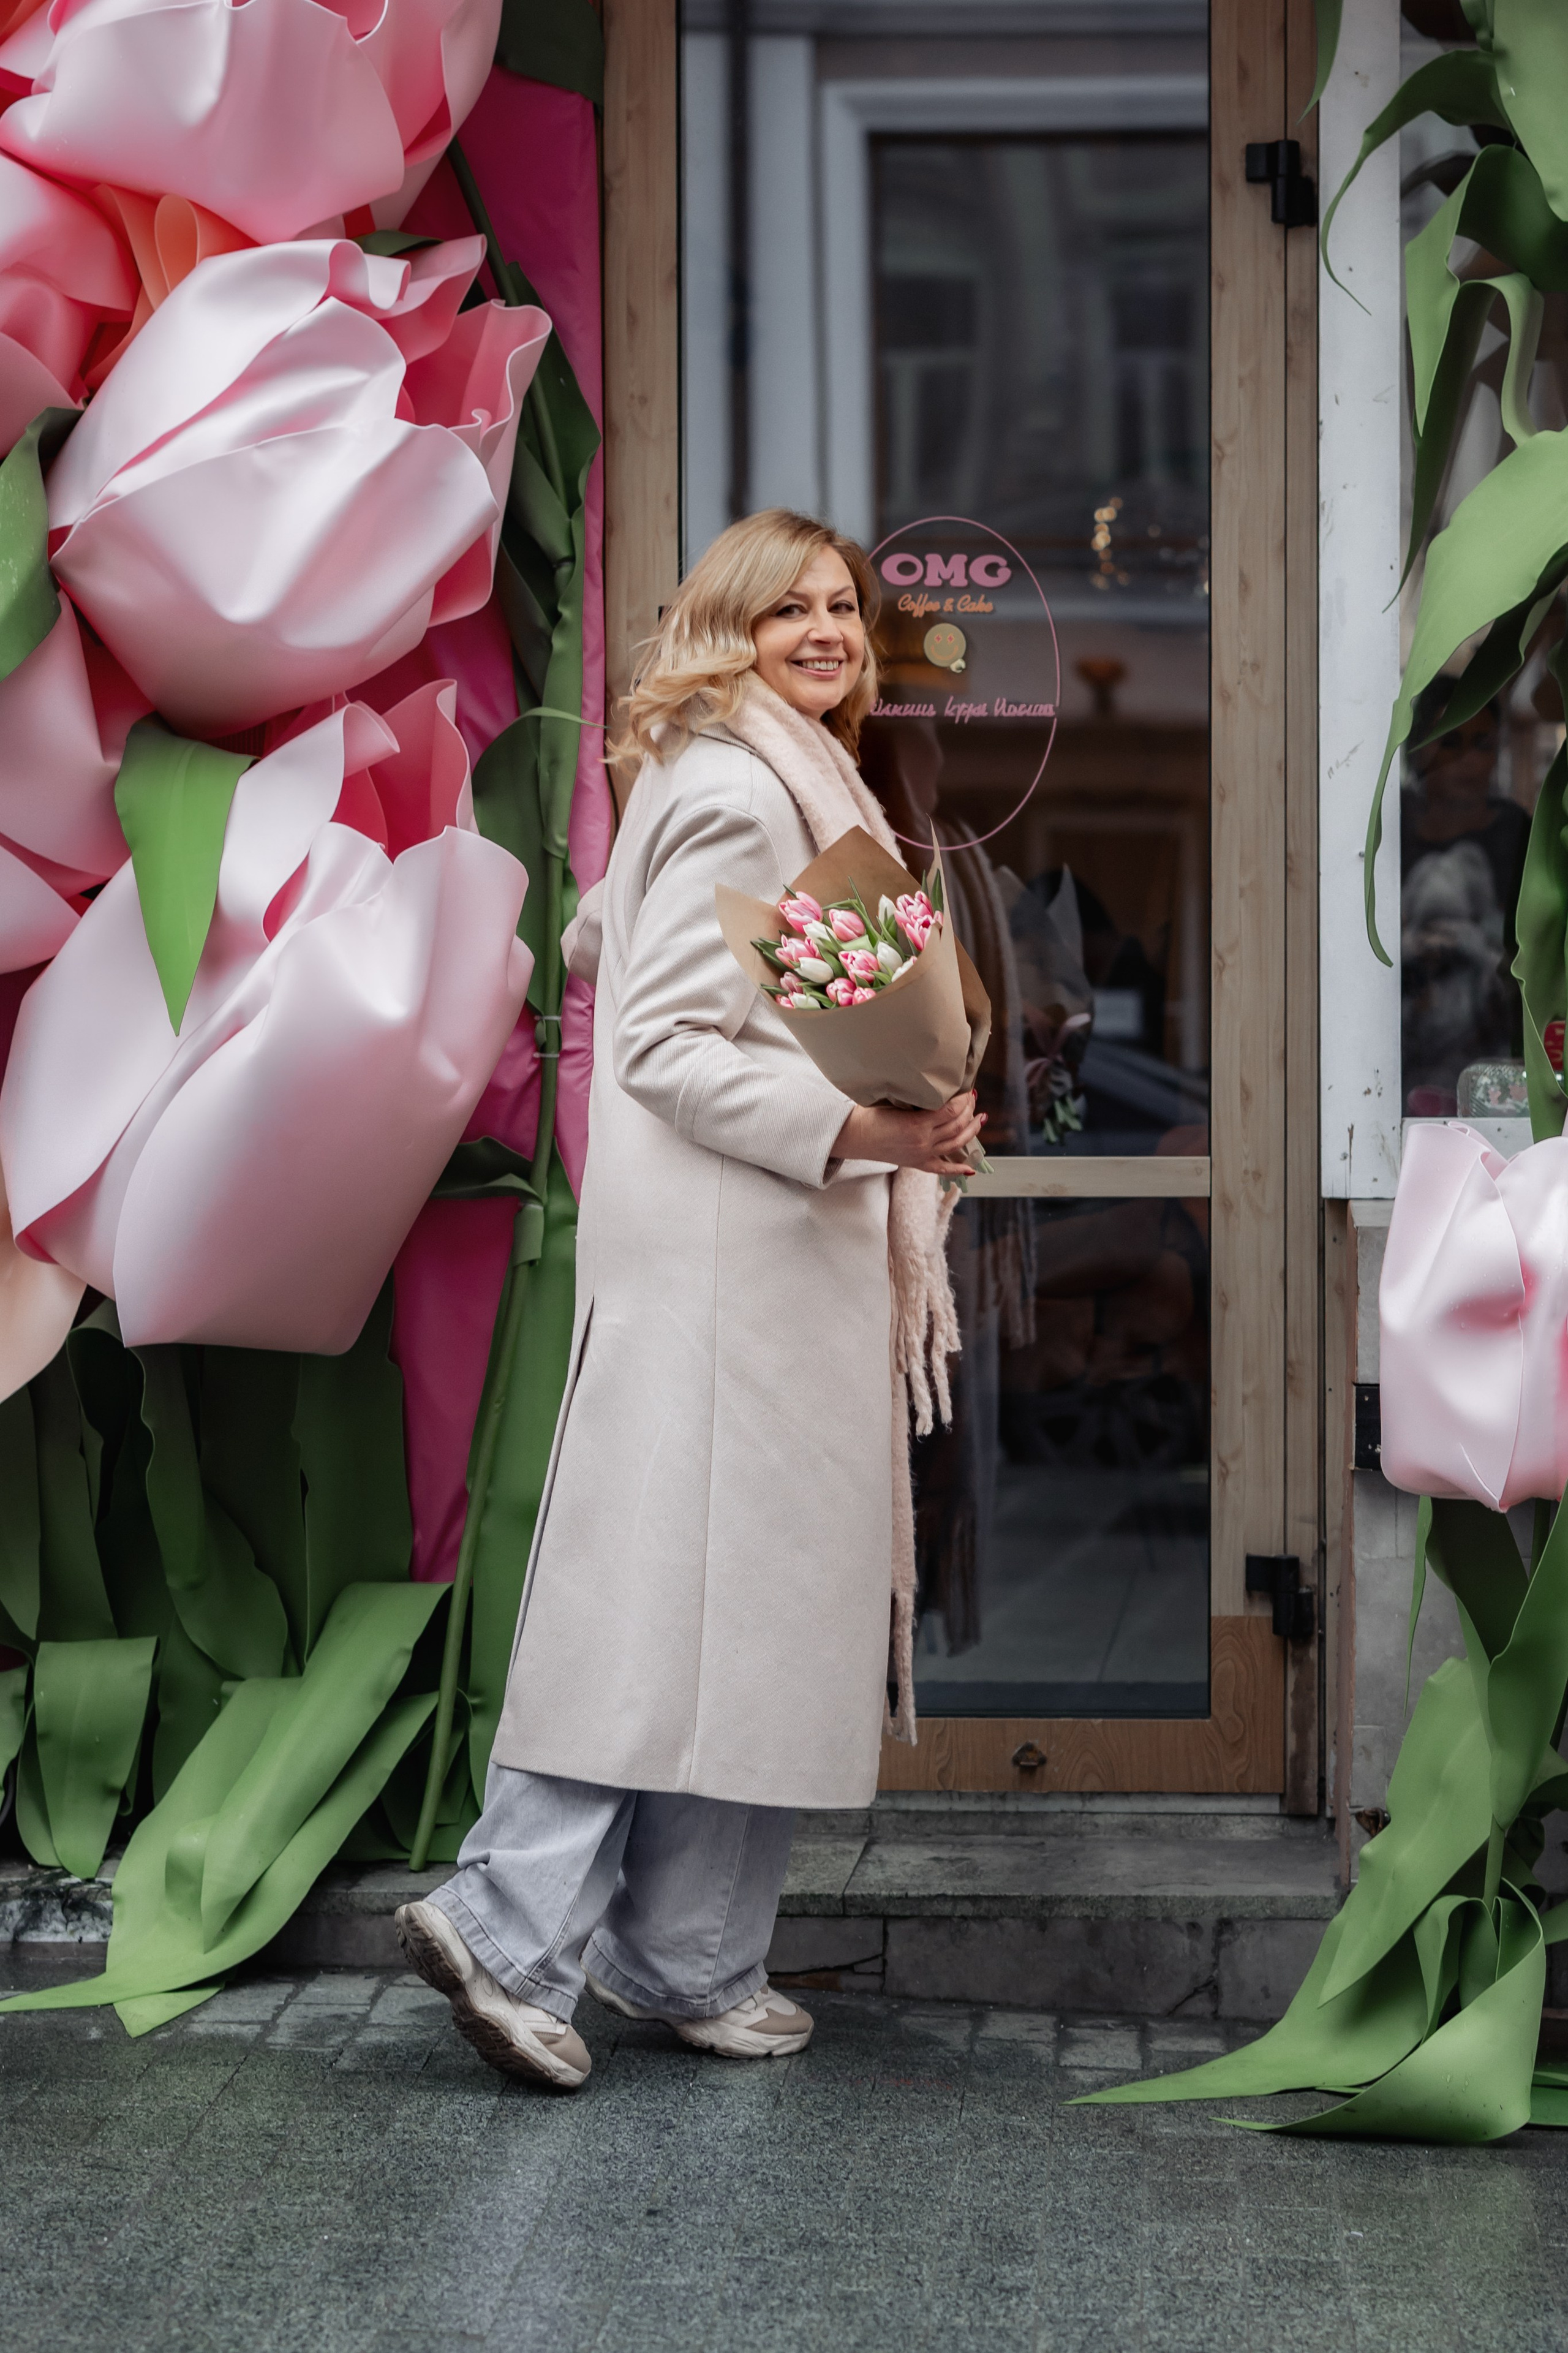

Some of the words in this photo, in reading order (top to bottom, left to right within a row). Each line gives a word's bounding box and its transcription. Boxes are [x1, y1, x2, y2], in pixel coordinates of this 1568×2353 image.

[881, 553, 1012, 587] OMG
[898, 593, 941, 618] Coffee
[943, 597, 954, 612] &
[957, 594, 993, 613] Cake
